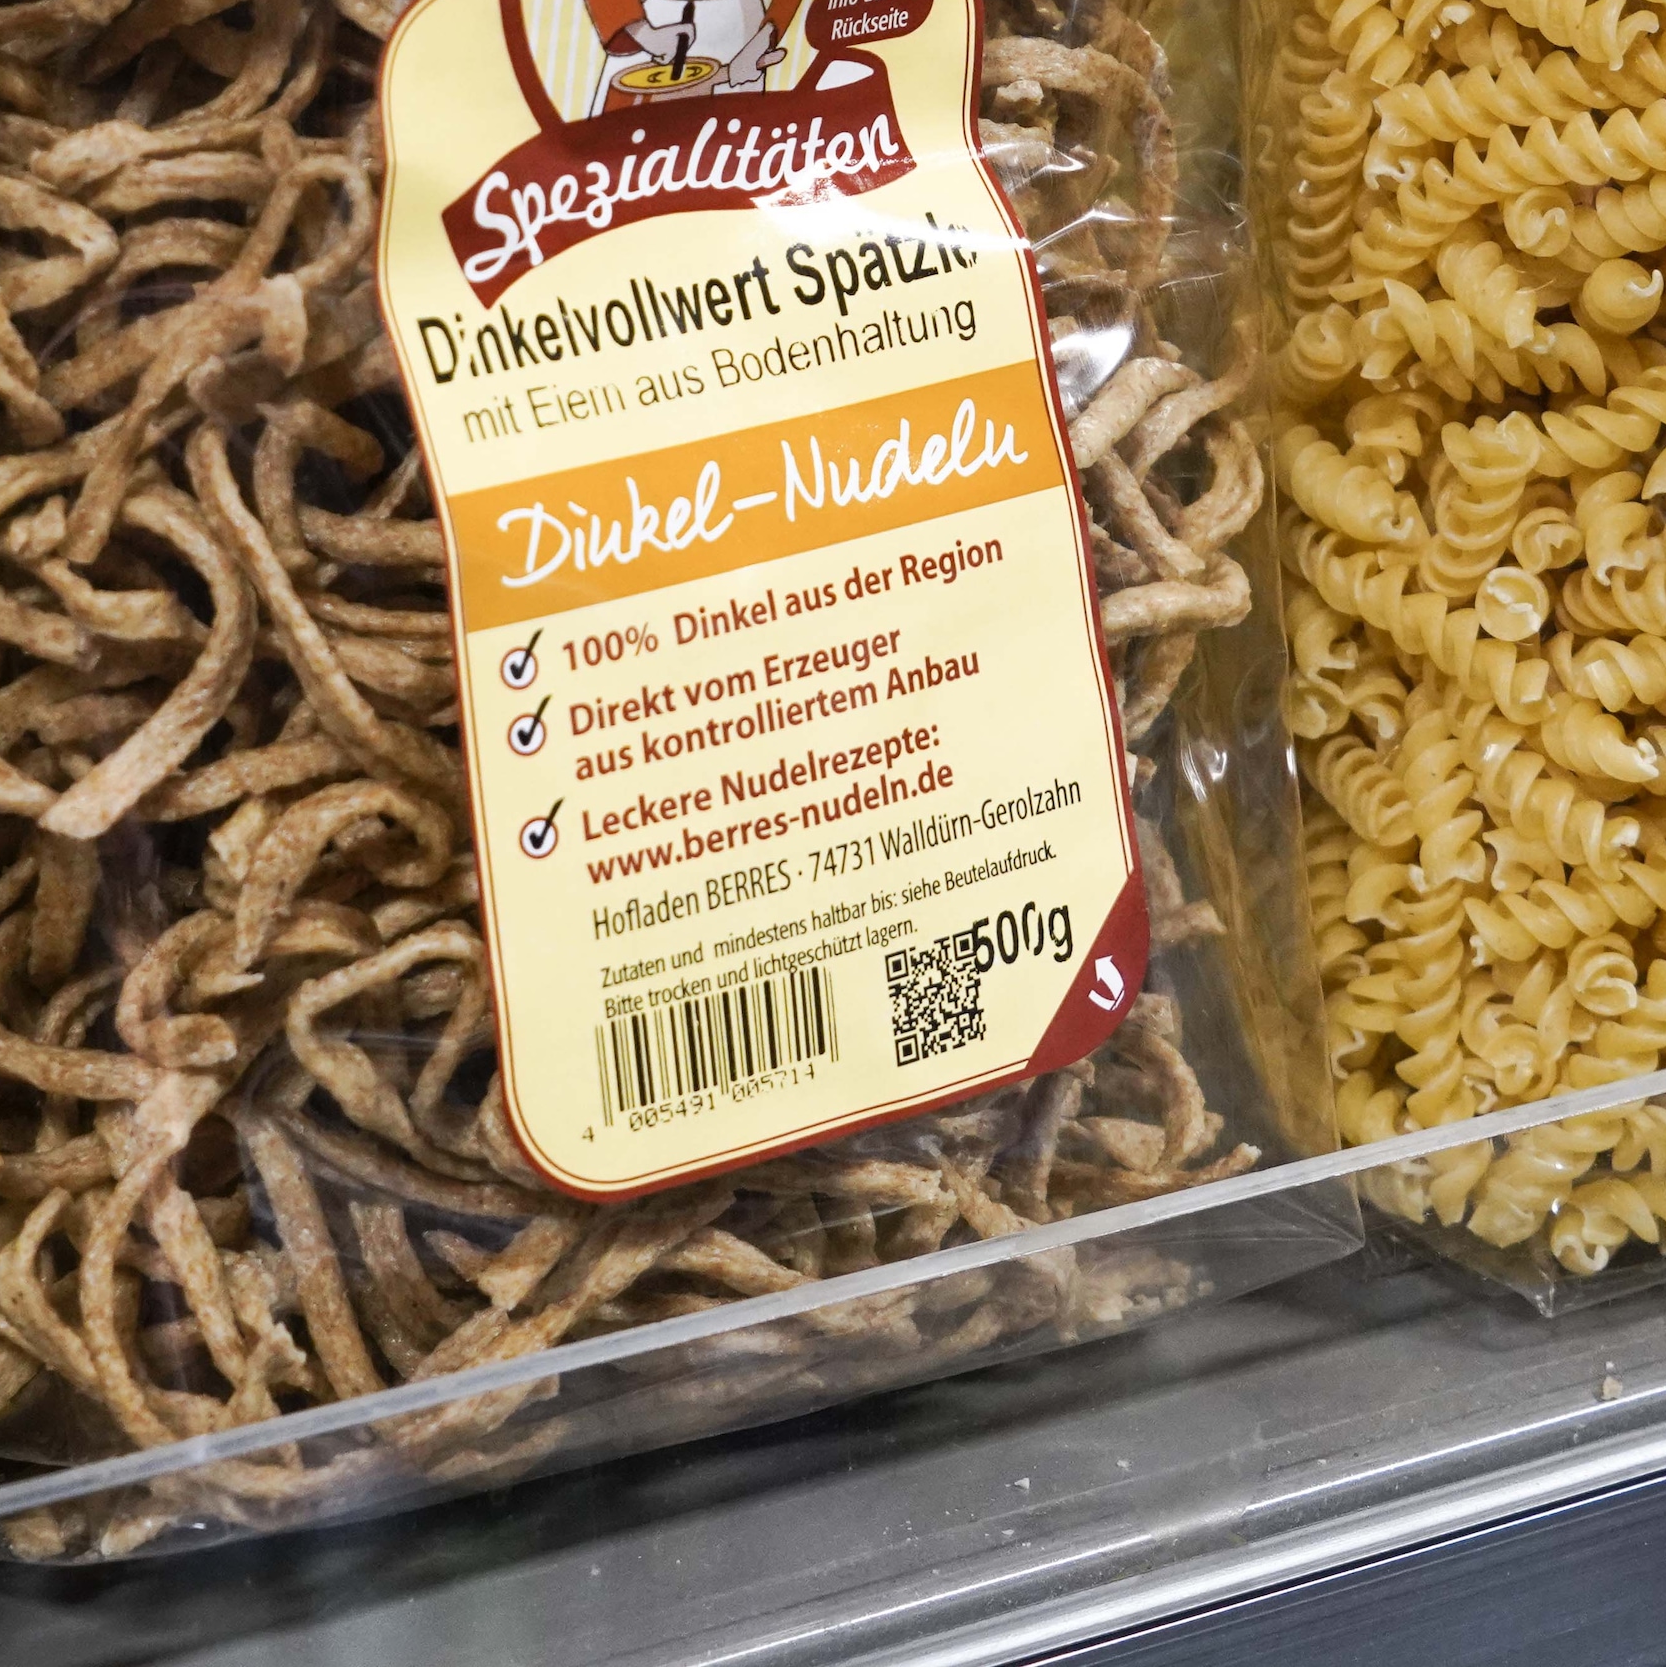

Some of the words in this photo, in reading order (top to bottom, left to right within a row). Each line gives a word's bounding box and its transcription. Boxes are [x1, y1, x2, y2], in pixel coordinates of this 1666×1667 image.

[831, 7, 909, 40] Rückseite
[464, 110, 899, 281] Spezialitäten
[463, 395, 522, 443] mit
[526, 382, 626, 429] Eiern
[635, 364, 705, 407] aus
[711, 298, 977, 388] Bodenhaltung
[495, 397, 1031, 588] Dinkel-Nudeln
[562, 622, 659, 671] 100%
[673, 589, 778, 645] Dinkel
[784, 582, 838, 617] aus
[844, 566, 893, 601] der
[899, 538, 1004, 586] Region
[569, 684, 677, 736] Direkt
[683, 669, 756, 707] vom
[763, 628, 901, 687] Erzeuger
[575, 745, 634, 781] aus
[641, 681, 878, 764] kontrolliertem
[886, 651, 980, 700] Anbau
[582, 787, 713, 842] Leckere
[720, 723, 941, 805] Nudelrezepte:
[586, 759, 955, 885] www.berres-nudeln.de
[593, 890, 700, 940] Hofladen
[706, 859, 791, 910] BERRES
[808, 836, 875, 881] 74731
[880, 778, 1081, 860] Walldürn-Gerolzahn
[601, 956, 666, 988] Zutaten
[671, 942, 704, 970] und
[714, 918, 807, 958] mindestens
[811, 901, 866, 931] haltbar
[871, 891, 897, 914] bis:
[902, 878, 941, 905] siehe
[944, 840, 1057, 891] Beutelaufdruck.
[605, 995, 643, 1019] Bitte
[648, 976, 711, 1007] trocken
[717, 962, 749, 989] und
[753, 931, 862, 978] lichtgeschützt
[865, 919, 918, 947] lagern.
[973, 901, 1073, 973] 500g
[582, 1126, 594, 1142] 4
